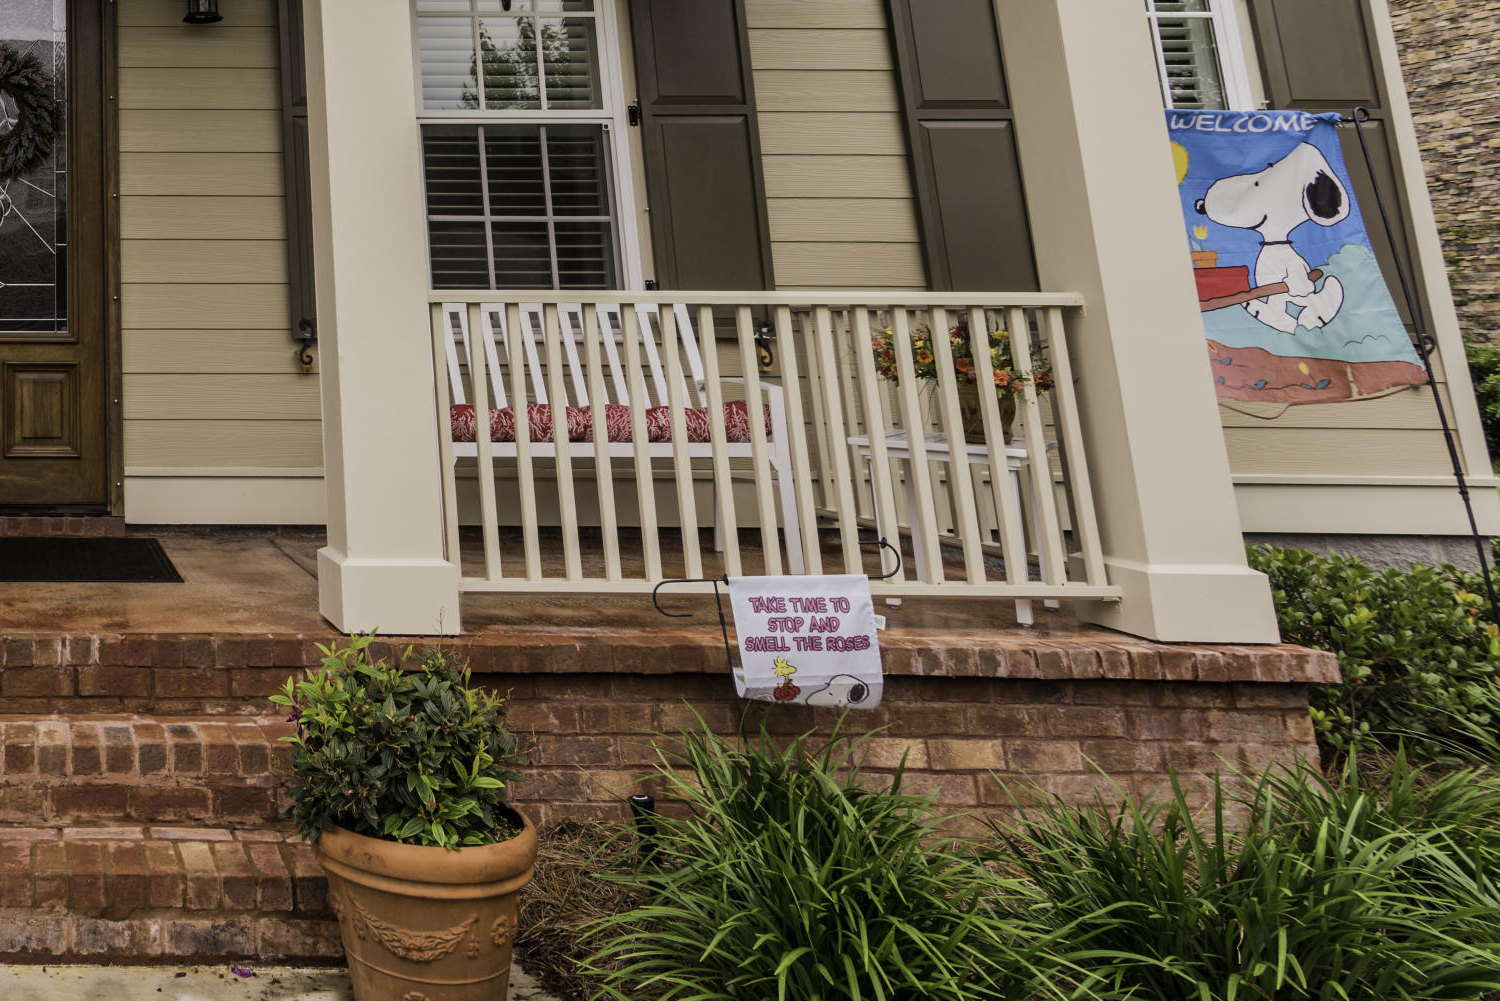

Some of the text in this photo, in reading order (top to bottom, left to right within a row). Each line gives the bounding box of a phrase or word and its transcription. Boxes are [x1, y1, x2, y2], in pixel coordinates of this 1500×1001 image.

[1171, 114, 1317, 133] WELCOME
[749, 597, 850, 613] TAKE TIME TO
[768, 616, 840, 633] STOP AND
[745, 635, 870, 652] SMELL THE ROSES
